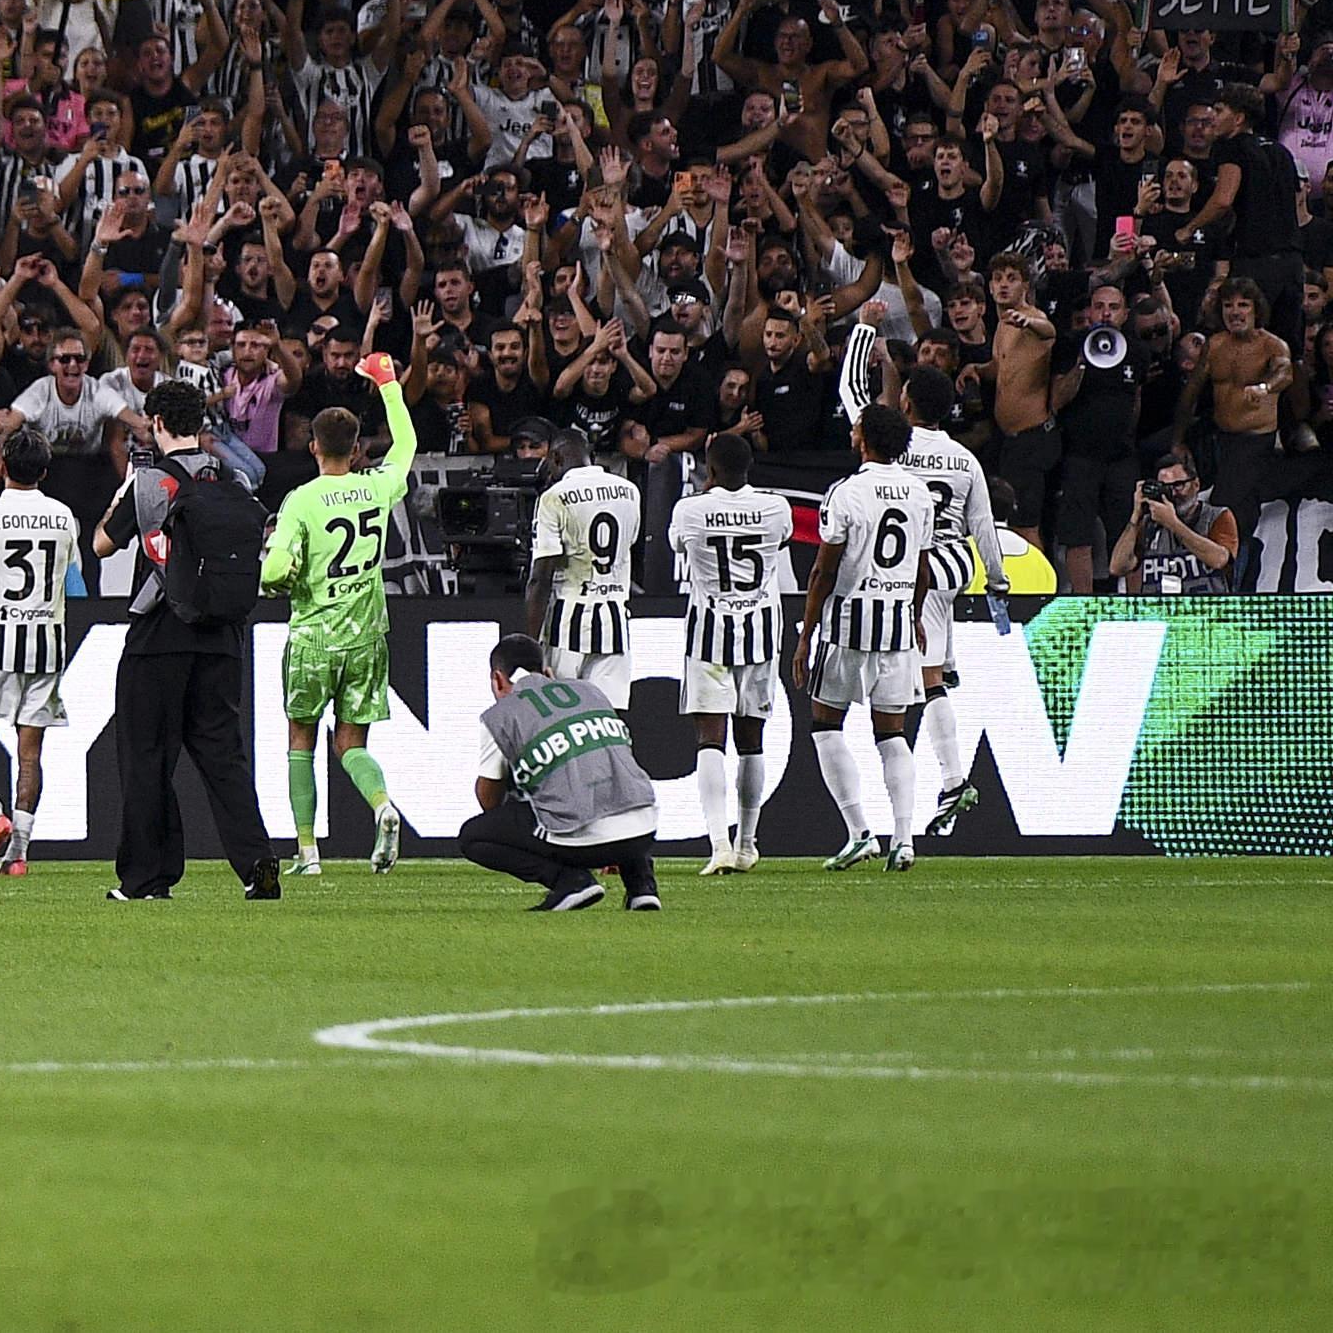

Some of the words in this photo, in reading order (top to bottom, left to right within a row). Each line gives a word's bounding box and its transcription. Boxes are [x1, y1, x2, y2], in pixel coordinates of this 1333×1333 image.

[499, 115, 533, 134] Jee
[893, 450, 944, 471] OUGLAS
[946, 456, 971, 473] LUIZ
[320, 487, 374, 508] VICARIO
[558, 489, 594, 507] KOLO
[596, 485, 636, 502] MUANI
[874, 484, 910, 501] KELLY
[704, 510, 763, 528] KALULU
[324, 506, 383, 580] 25
[588, 510, 620, 576] 9
[873, 507, 909, 570] 6
[2, 538, 58, 604] 31
[707, 533, 765, 593] 15
[867, 576, 917, 593] Cygame
[517, 681, 582, 719] 10
[253, 618, 1168, 840] NOW
[514, 731, 571, 785] CLUB
